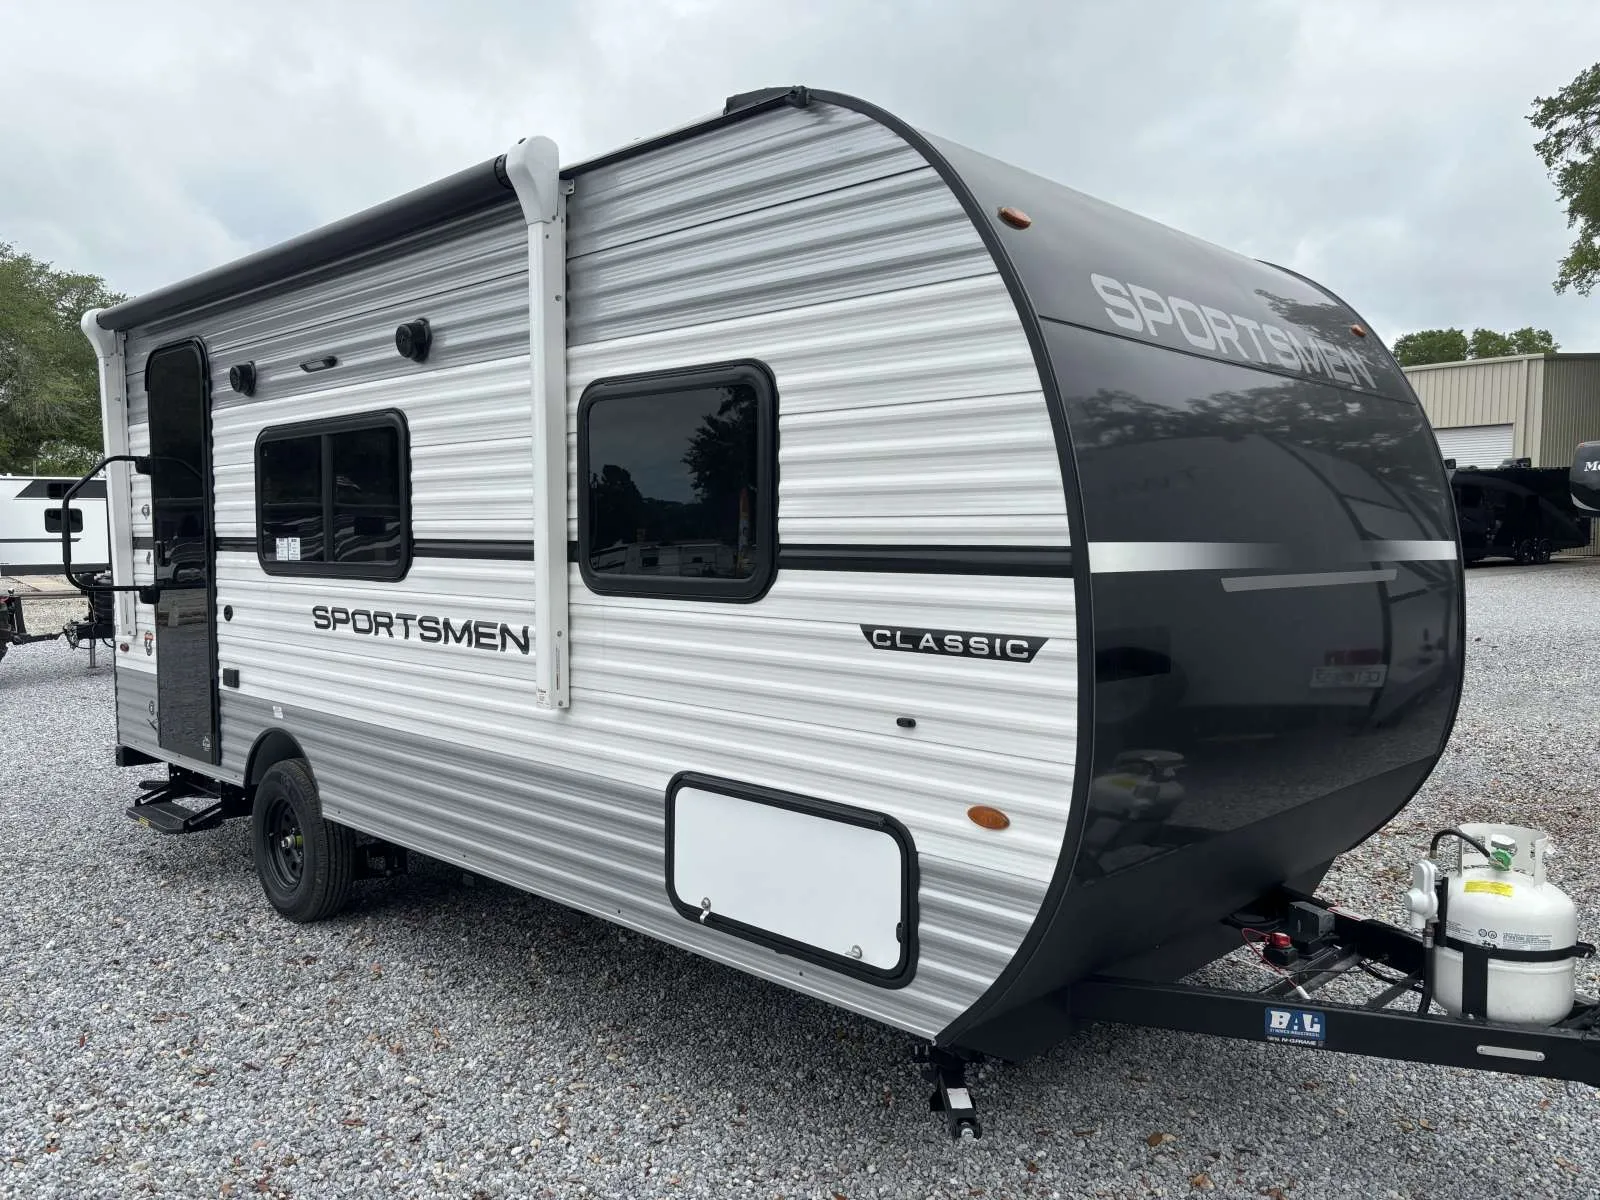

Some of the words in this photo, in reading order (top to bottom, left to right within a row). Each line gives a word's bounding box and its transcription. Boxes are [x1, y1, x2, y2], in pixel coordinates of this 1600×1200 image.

[1090, 272, 1377, 389] SPORTSMEN
[312, 605, 530, 655] SPORTSMEN
[872, 629, 1029, 659] CLASSIC
[1270, 1010, 1321, 1033] BAL
